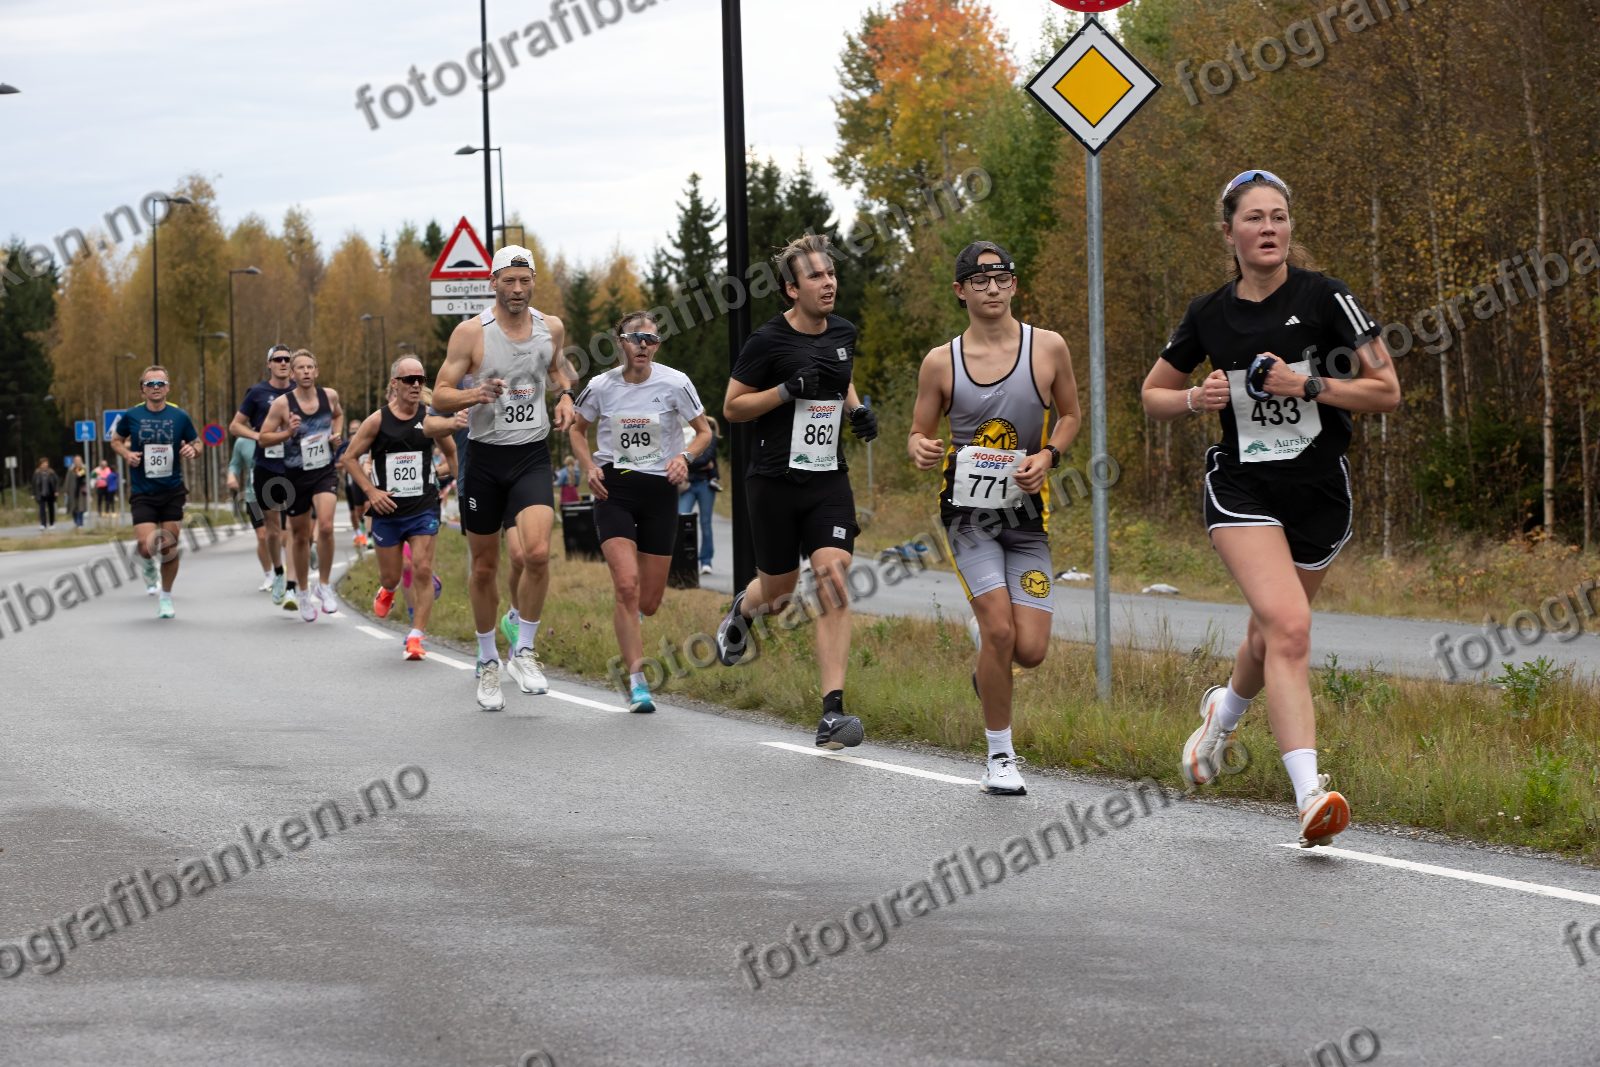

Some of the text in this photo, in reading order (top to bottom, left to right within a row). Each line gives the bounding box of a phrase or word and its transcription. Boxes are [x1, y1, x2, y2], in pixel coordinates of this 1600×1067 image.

[444, 284, 486, 294] Gangfelt
[447, 302, 454, 311] 0
[464, 302, 468, 310] 1
[470, 302, 485, 310] km
[505, 404, 534, 423] 382
[1251, 397, 1301, 426] 433
[620, 431, 651, 449] 849
[804, 424, 833, 445] 862
[307, 444, 325, 457] 774
[150, 456, 167, 466] 361
[971, 452, 1015, 463] NORGES
[975, 460, 1008, 470] LØPET
[394, 467, 417, 480] 620
[968, 473, 1009, 499] 771
